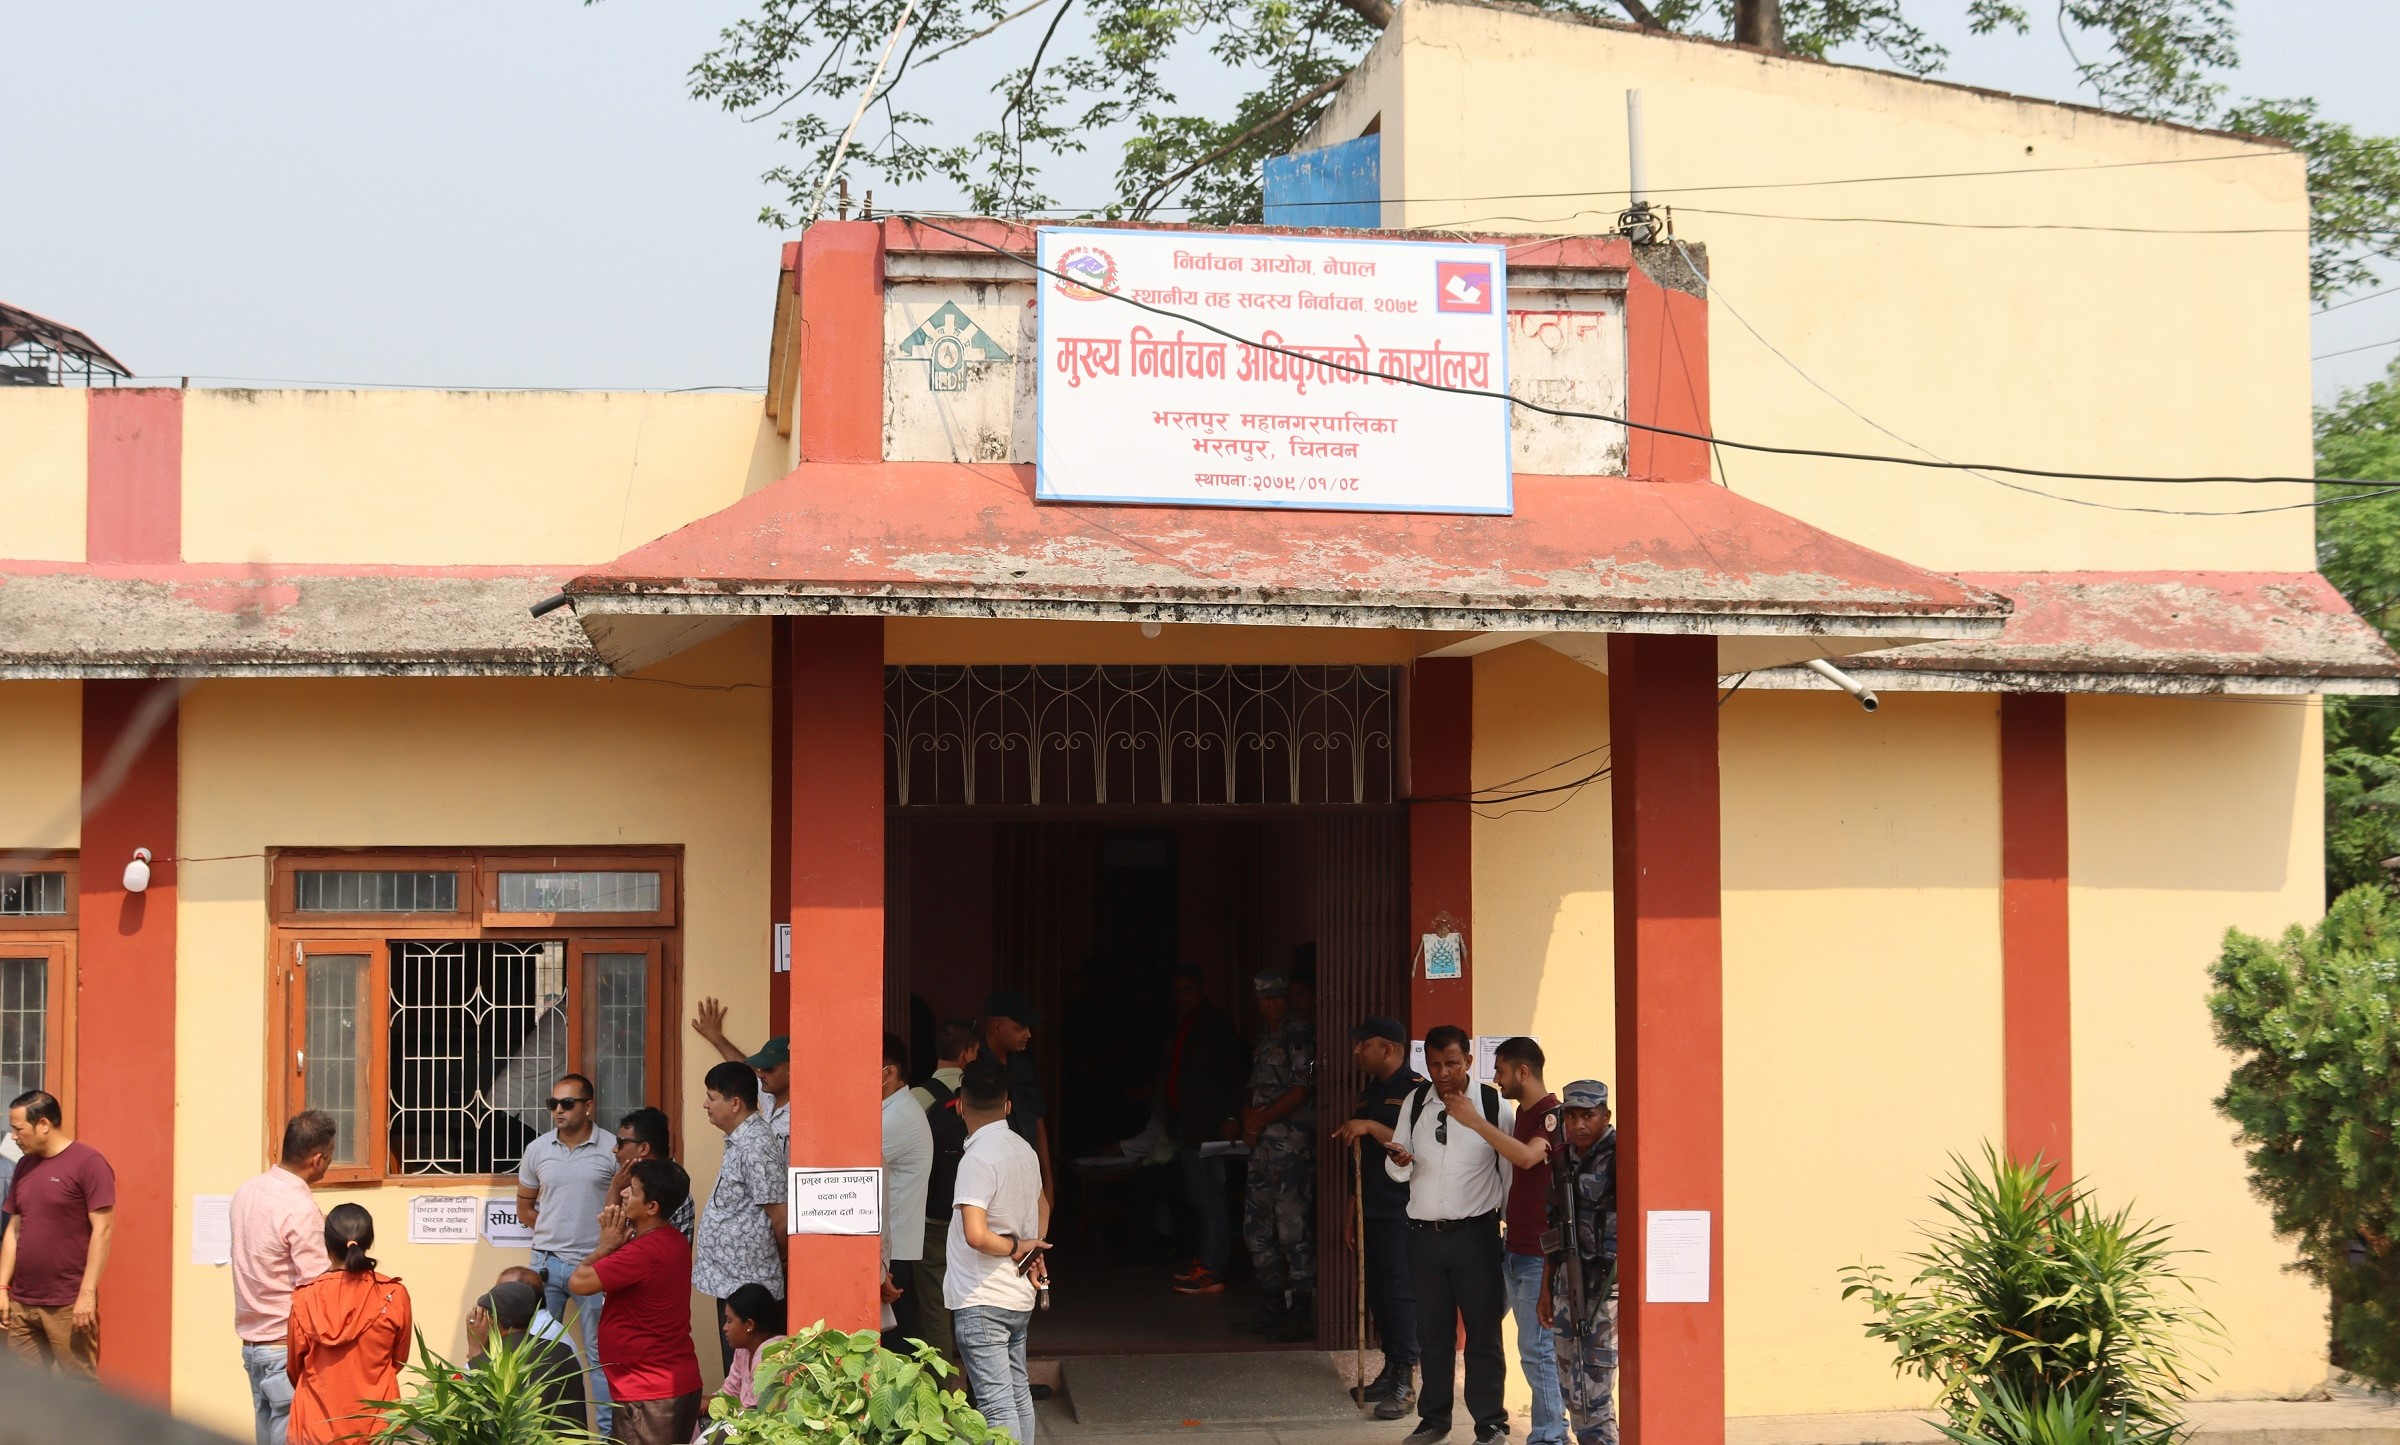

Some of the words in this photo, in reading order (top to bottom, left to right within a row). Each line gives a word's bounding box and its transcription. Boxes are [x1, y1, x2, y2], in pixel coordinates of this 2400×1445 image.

[1173, 250, 1244, 272] निर्वाचन
[1323, 256, 1377, 277] नेपाल
[1131, 286, 1199, 306] स्थानीय
[1204, 292, 1232, 308] तह
[1237, 293, 1292, 310] सदस्य
[1374, 298, 1418, 314] २०७९
[1056, 337, 1122, 389] मुख्य
[1130, 325, 1227, 380] निर्वाचन
[1235, 329, 1370, 396] अधिकृतको
[1378, 338, 1490, 390] कार्यालय
[1152, 410, 1231, 435] भरतपुर
[1240, 411, 1398, 435] महानगरपालिका
[1192, 438, 1275, 462] भरतपुर,
[1288, 435, 1360, 459] चितवन
[824, 1176, 839, 1184] तथा
[490, 1209, 528, 1229] सोध
